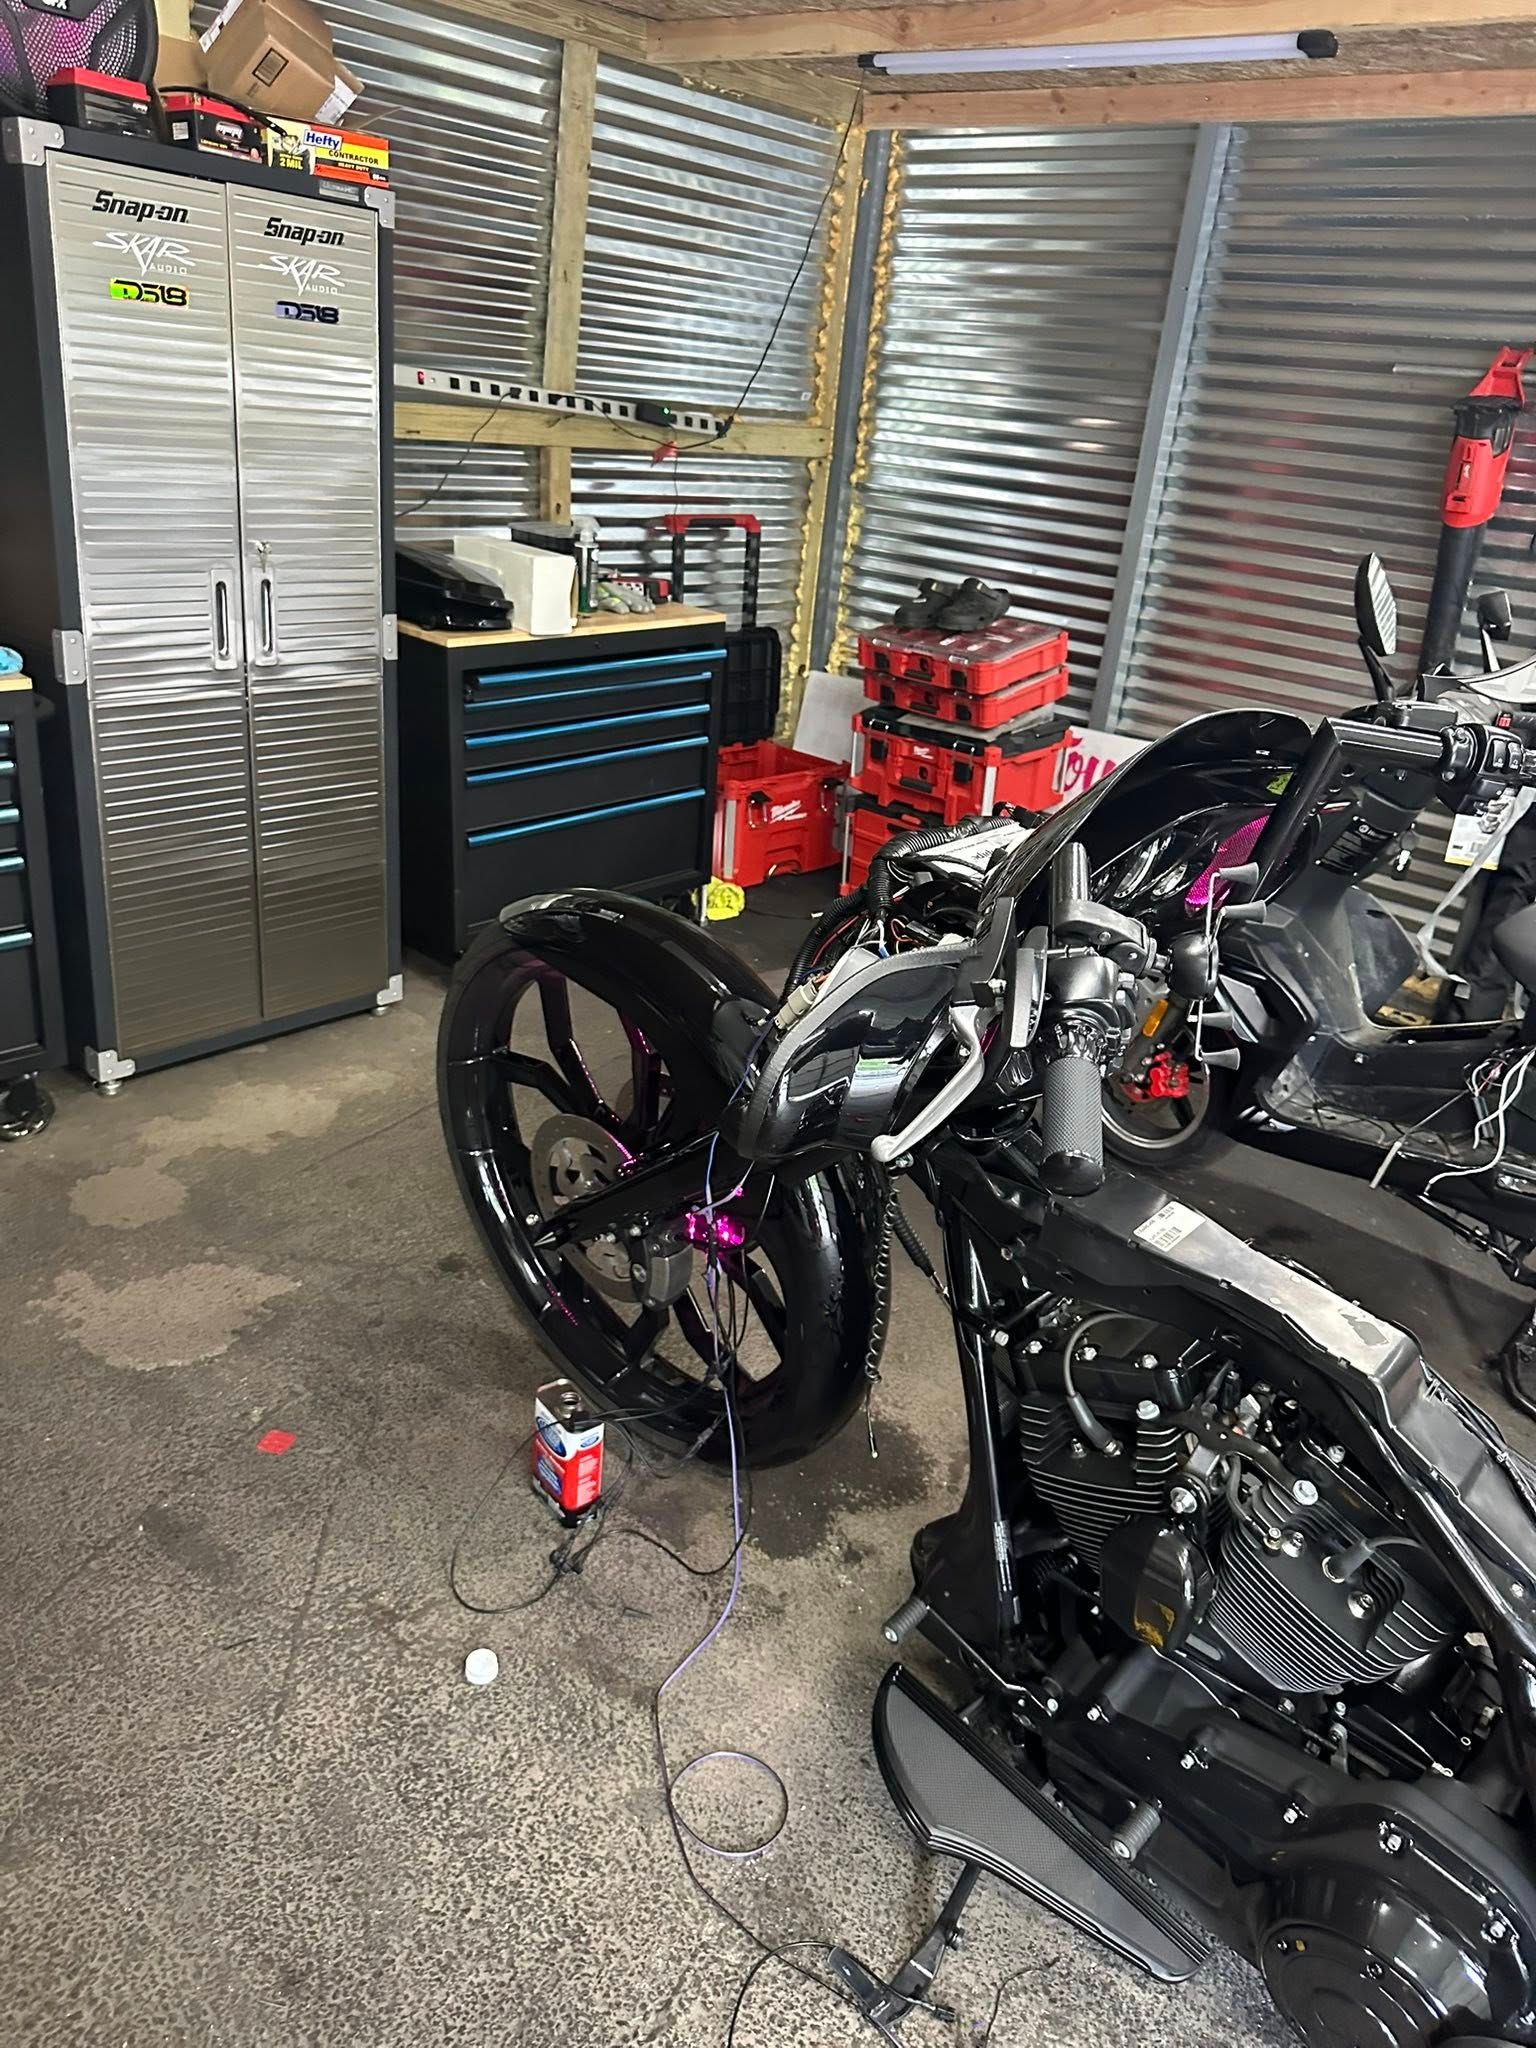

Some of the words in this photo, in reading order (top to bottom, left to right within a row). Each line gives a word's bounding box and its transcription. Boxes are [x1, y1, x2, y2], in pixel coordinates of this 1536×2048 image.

[306, 132, 340, 150] Hefty
[280, 158, 286, 167] 2
[286, 159, 303, 170] MIL
[328, 150, 379, 165] CONTRACTOR
[92, 190, 188, 222] Snap-on
[264, 217, 344, 246] Snap-on
[92, 232, 196, 276] SKAR
[149, 263, 188, 275] AUDIO
[256, 256, 345, 296] SKAR
[305, 284, 338, 295] AUDIO
